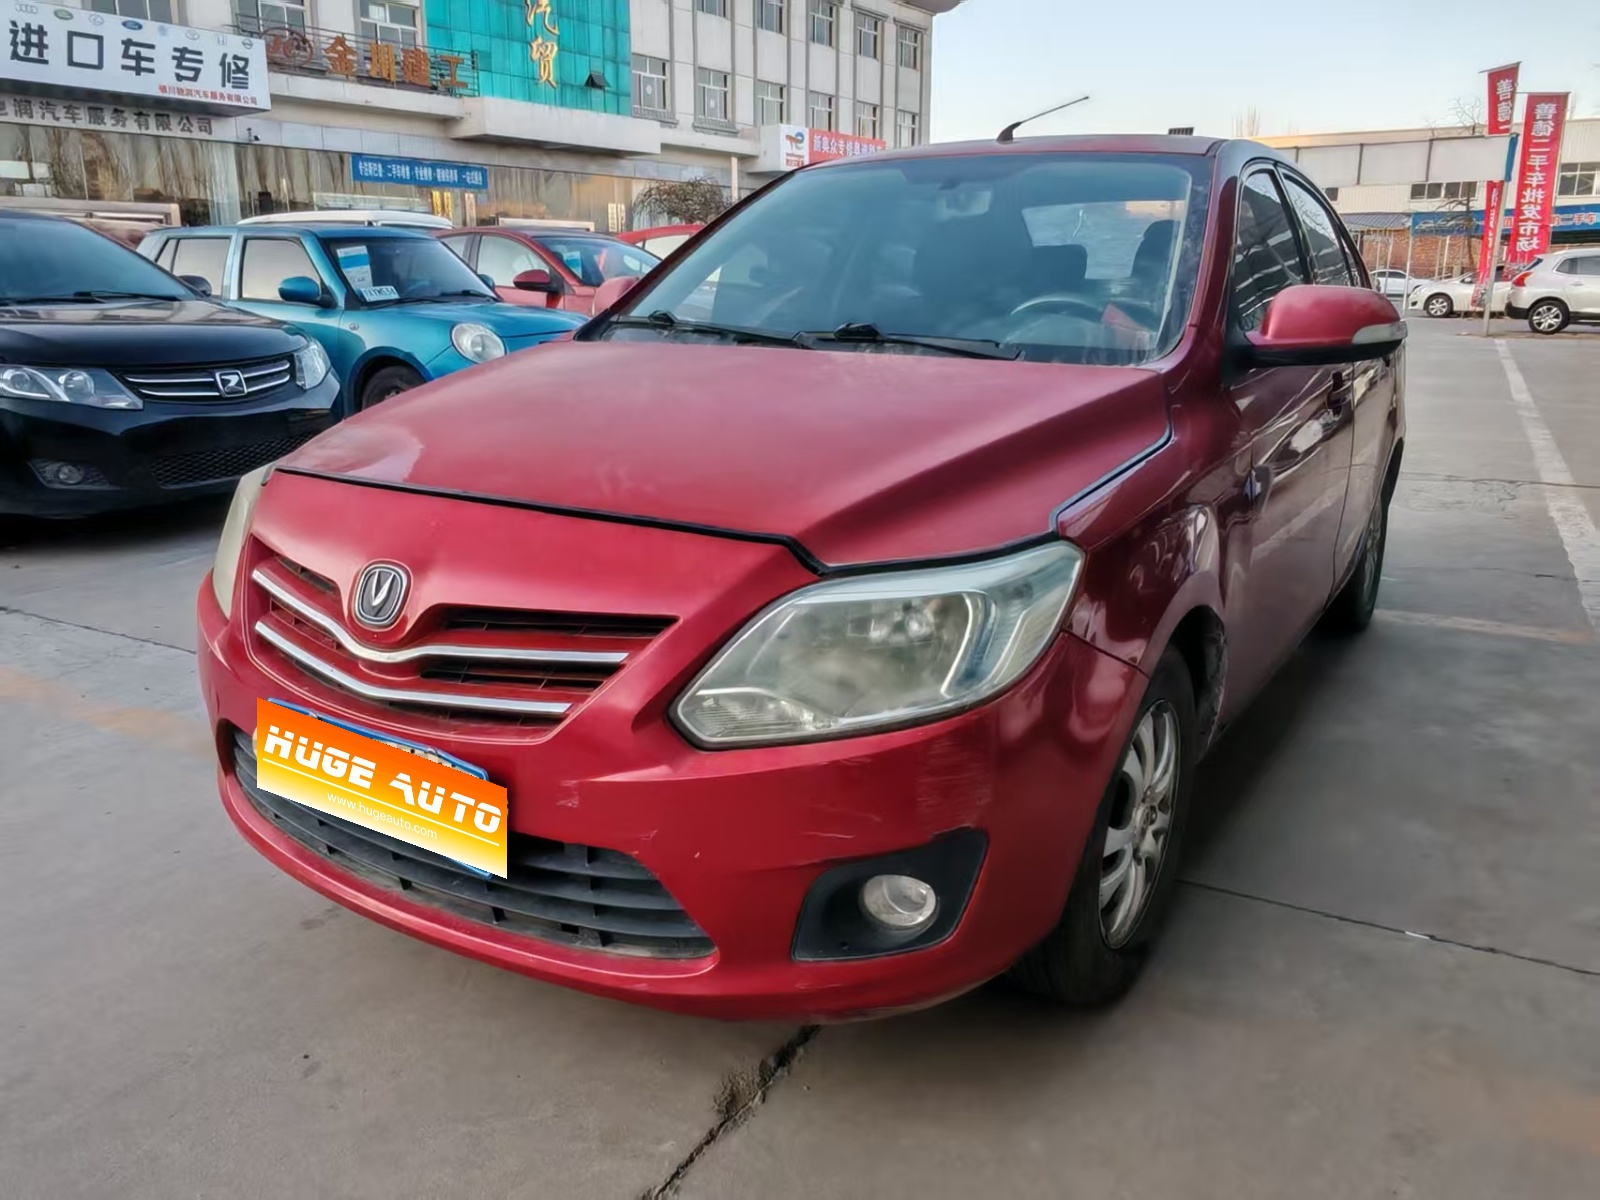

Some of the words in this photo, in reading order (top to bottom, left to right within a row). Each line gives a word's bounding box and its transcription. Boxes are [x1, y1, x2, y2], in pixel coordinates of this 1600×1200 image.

[9, 20, 249, 89] 进口车专修
